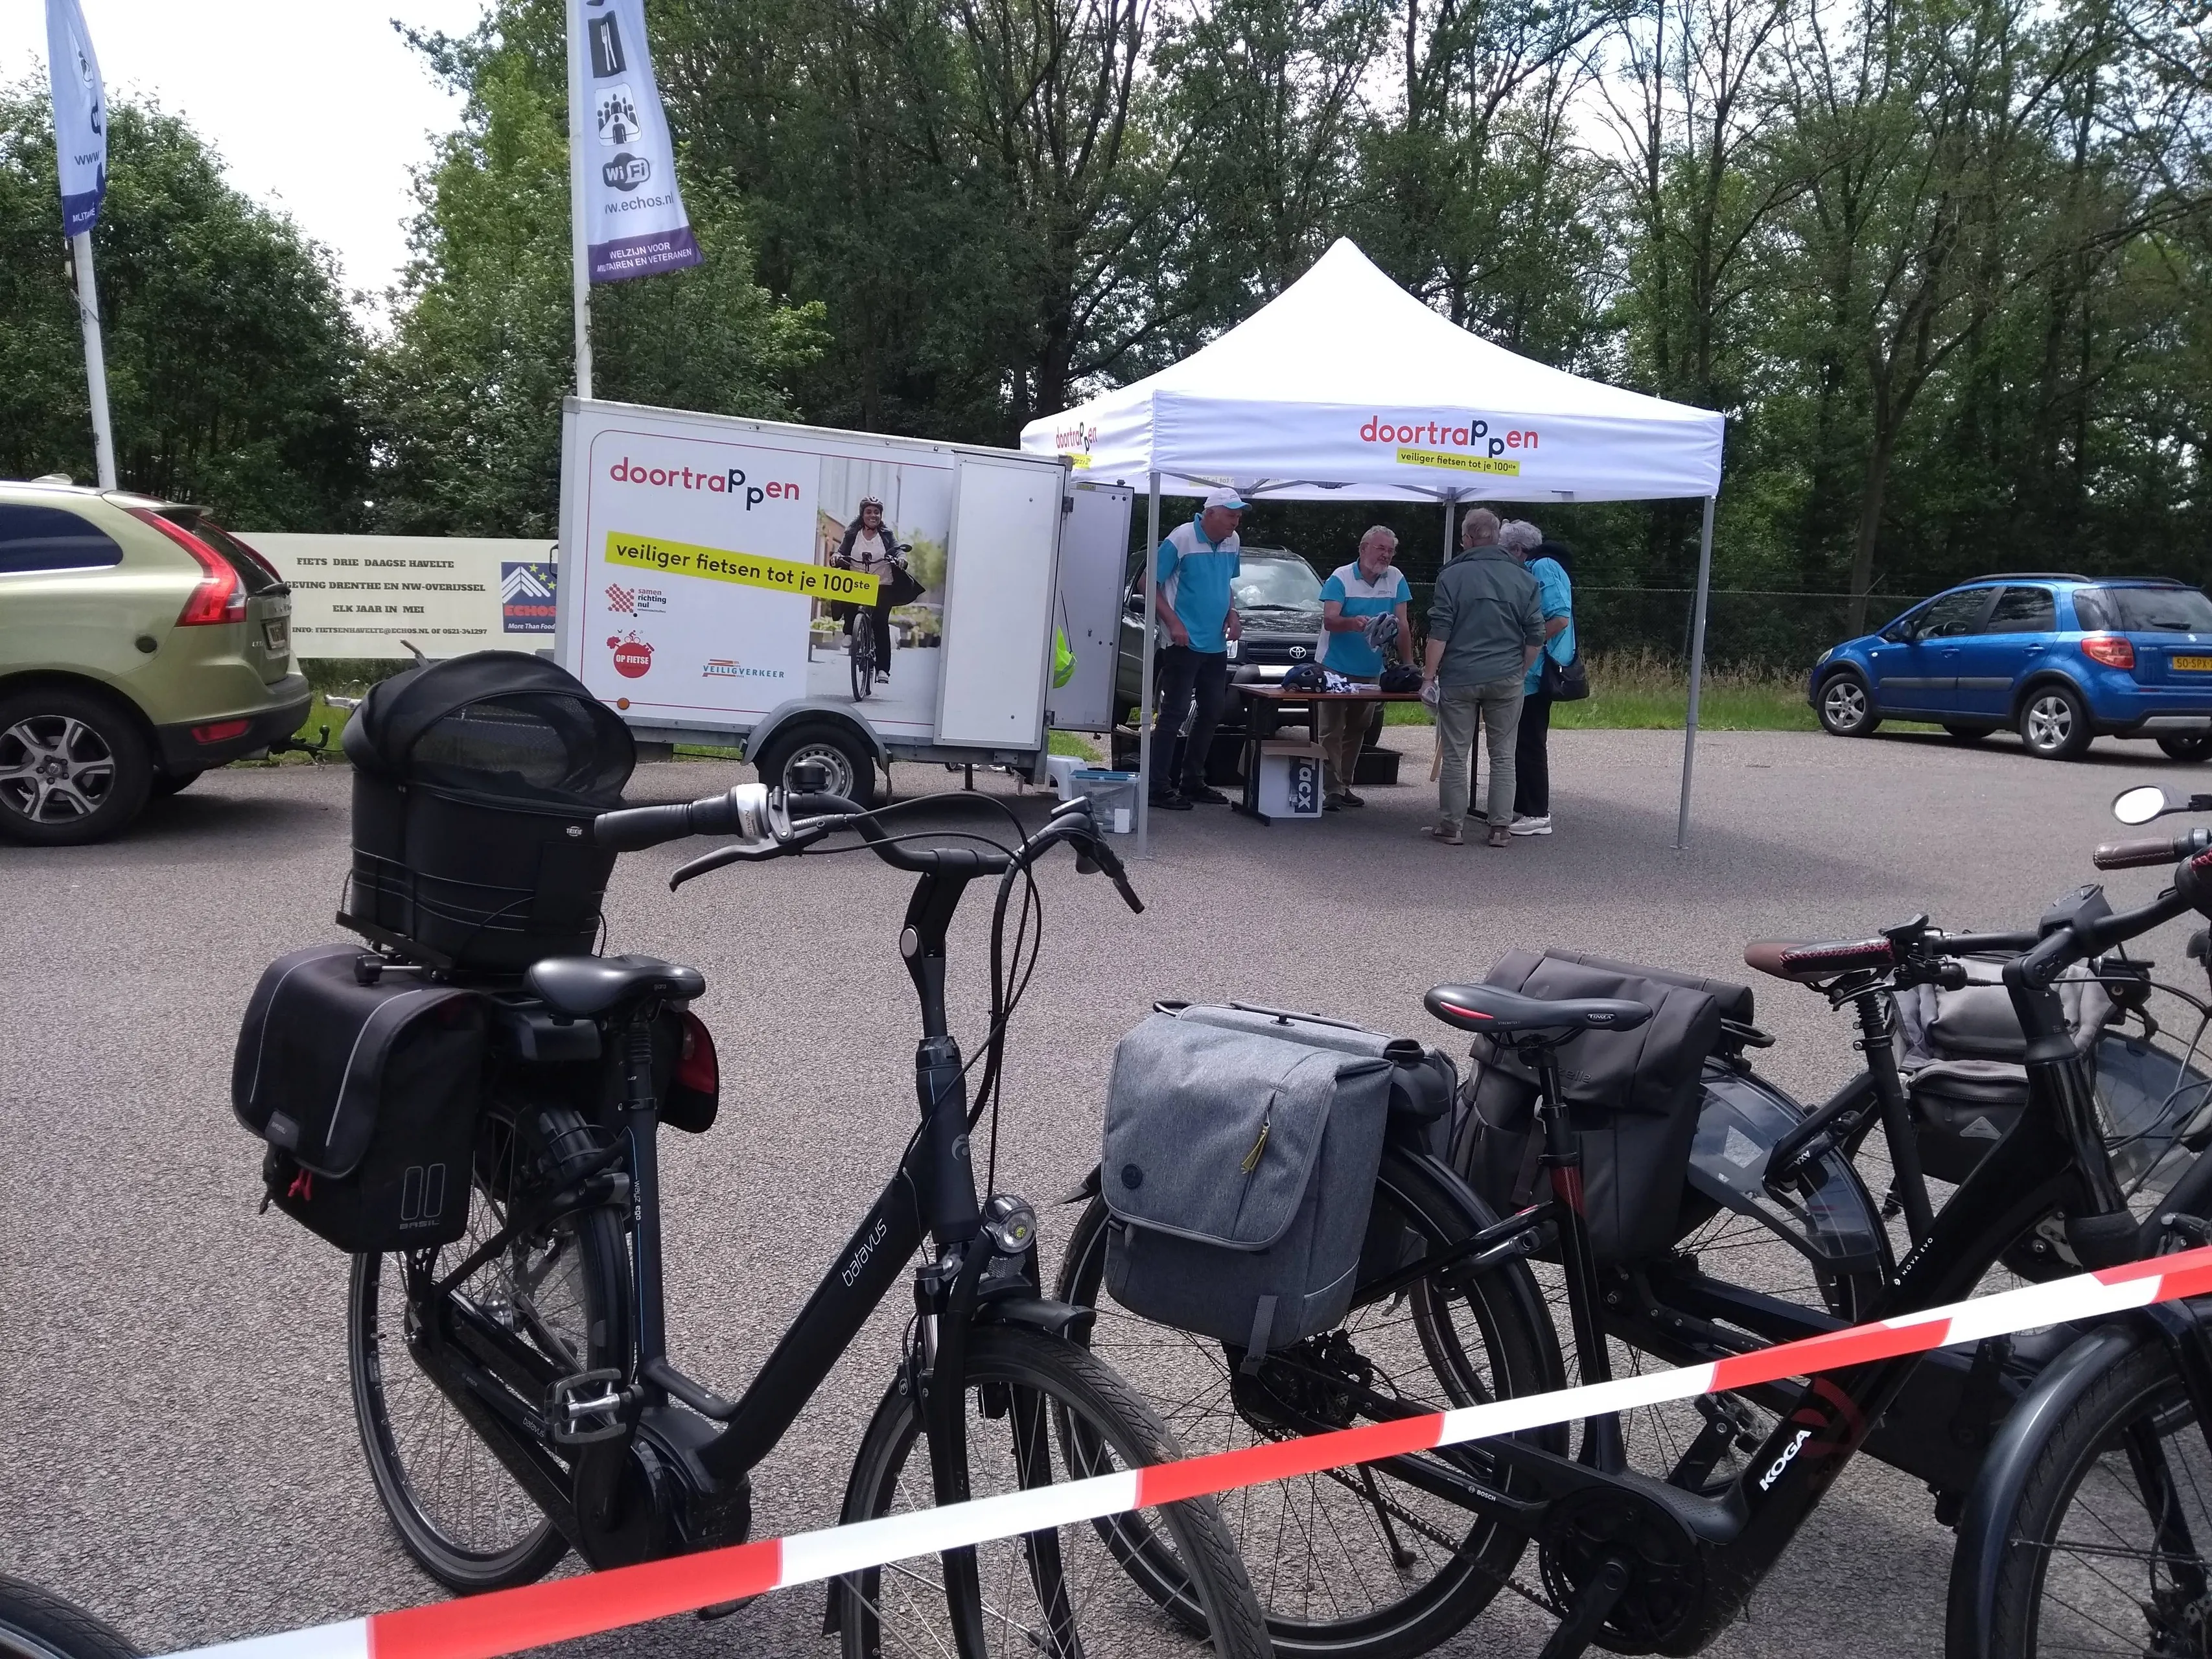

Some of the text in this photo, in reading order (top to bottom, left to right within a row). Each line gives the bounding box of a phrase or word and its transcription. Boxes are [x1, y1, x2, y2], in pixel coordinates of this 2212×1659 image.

[597, 248, 692, 272] MILITAIREN EN VETERANEN
[609, 242, 671, 259] WELZIJN VOOR
[1056, 421, 1098, 455] doortrappen
[1360, 415, 1539, 458] doortrappen
[1401, 452, 1516, 472] veiliger fietsen tot je 100ste
[609, 456, 800, 511] doortrappen
[296, 557, 328, 566] FIETS
[332, 558, 359, 566] DRIE
[408, 560, 454, 568] HAVELTE
[616, 544, 870, 594] veiliger fietsen tot je 100ste
[284, 581, 326, 589] GEVING
[329, 581, 382, 590] DRENTHE
[638, 595, 667, 604] richting
[504, 605, 556, 616] ECHOS
[616, 655, 649, 665] OP FIETSE
[1298, 757, 1316, 809] Tacx
[744, 809, 753, 836] Nexus
[1558, 1066, 1592, 1084] zelle
[1793, 1150, 1811, 1165] AXA
[399, 1220, 440, 1230] BASIL
[842, 1218, 887, 1286] batavus
[1901, 1238, 1933, 1276] NOVA EVO
[522, 1417, 544, 1438] batavus
[1759, 1430, 1812, 1491] KOGA
[1476, 1489, 1496, 1502] BOSCH
